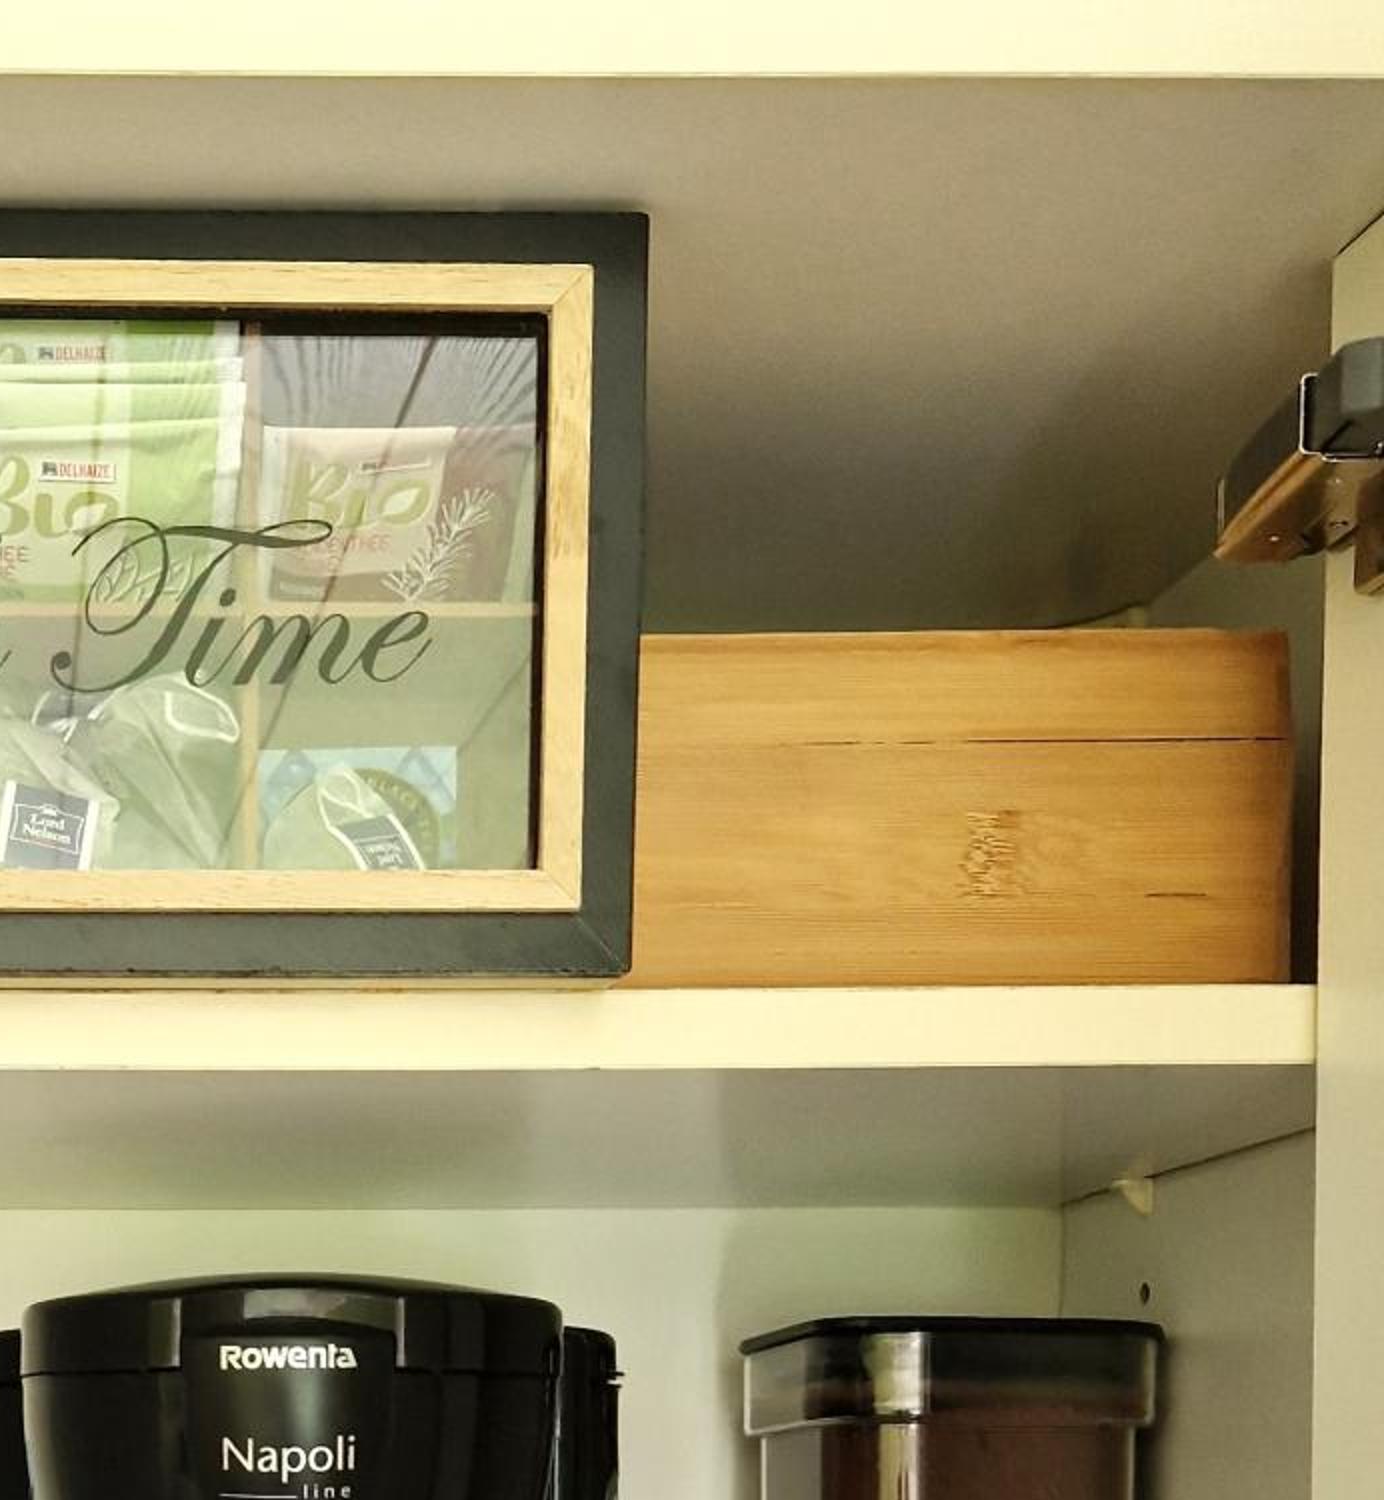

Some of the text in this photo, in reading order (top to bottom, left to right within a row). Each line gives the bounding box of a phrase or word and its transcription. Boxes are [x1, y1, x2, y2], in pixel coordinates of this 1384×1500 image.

[58, 463, 109, 479] DELHAIZE
[50, 517, 433, 692] Time
[219, 1343, 358, 1370] Rowenta
[222, 1435, 356, 1483] Napoli
[303, 1483, 352, 1499] line
